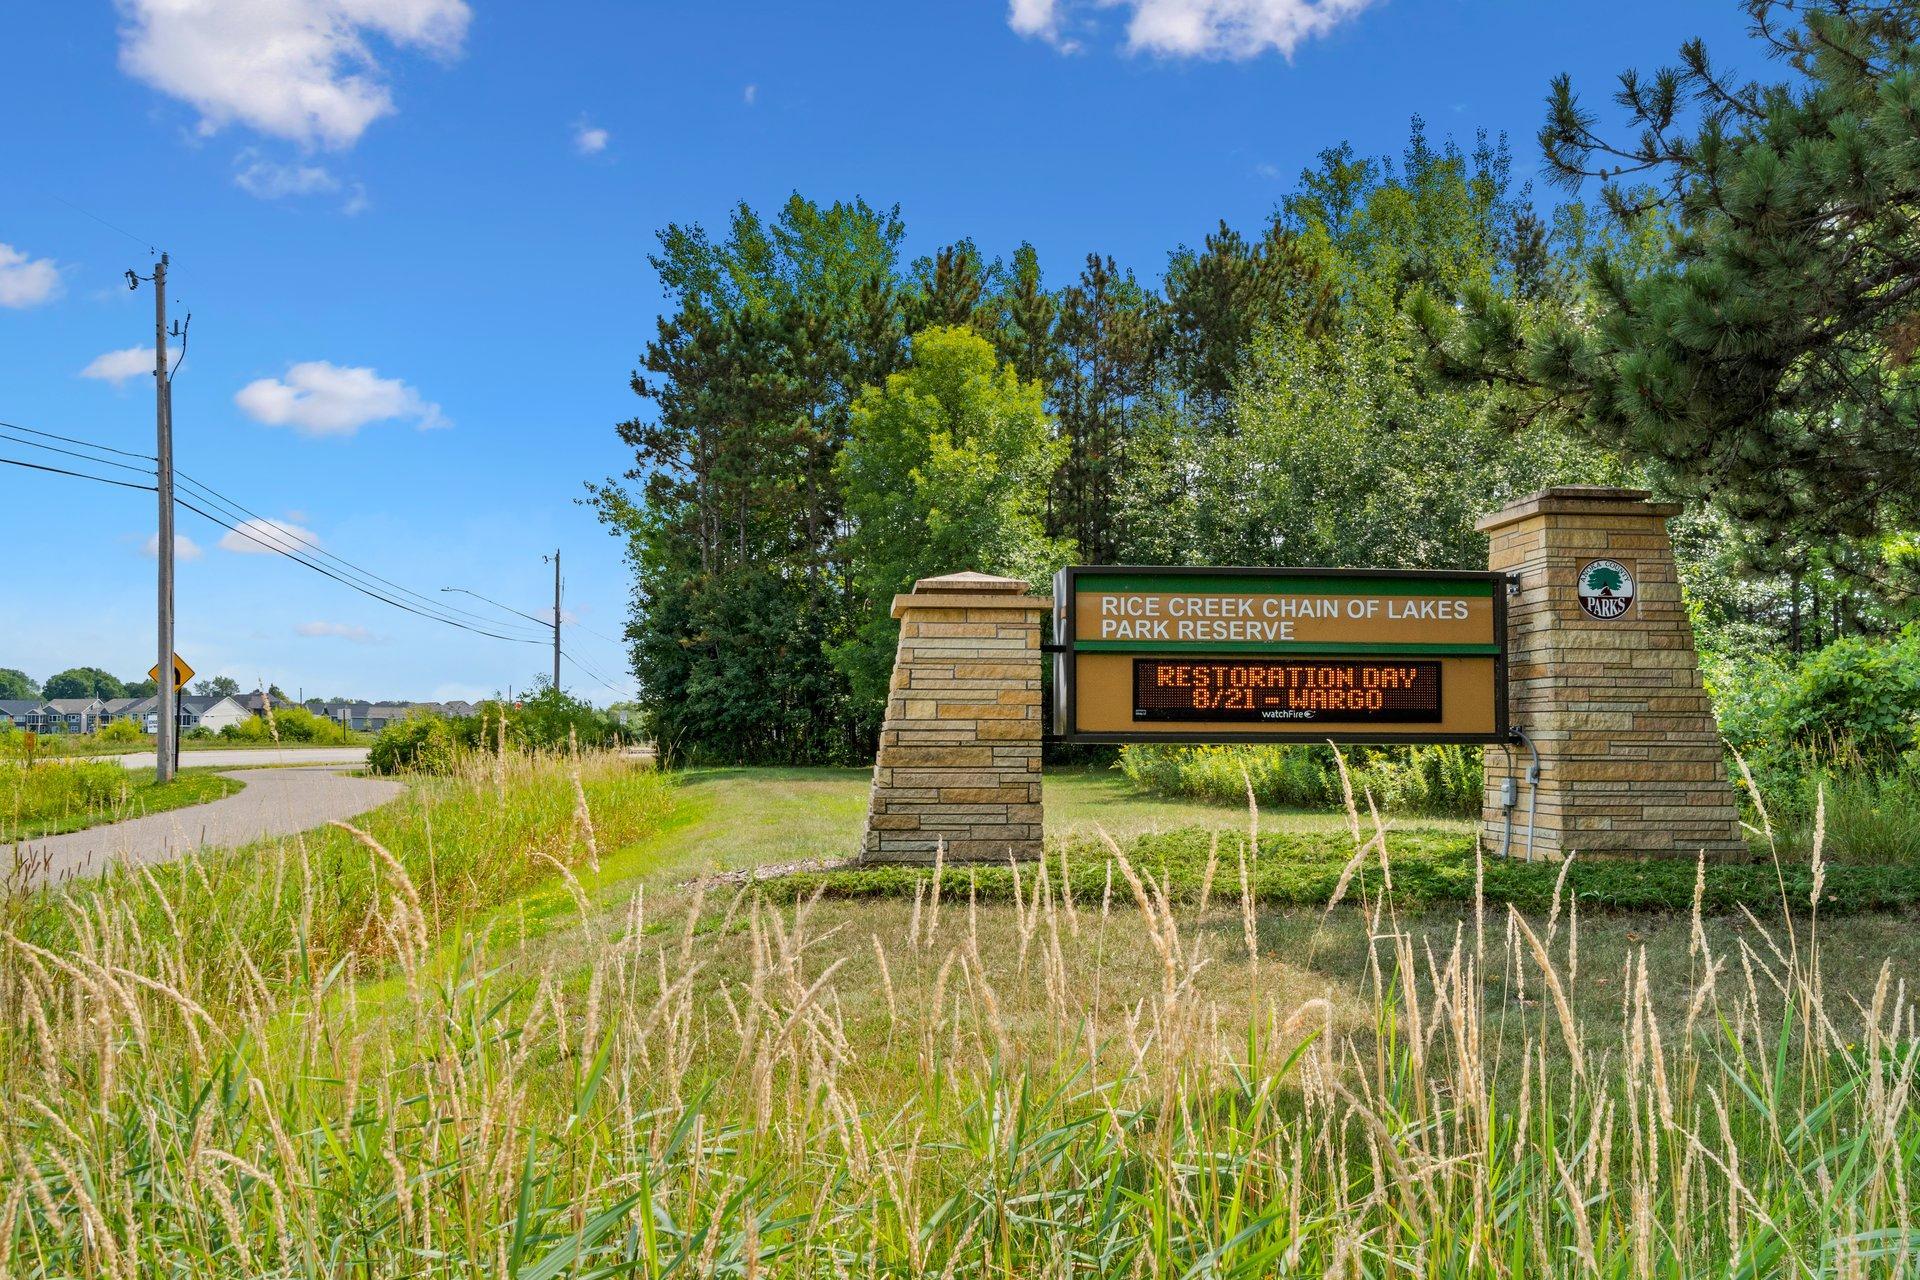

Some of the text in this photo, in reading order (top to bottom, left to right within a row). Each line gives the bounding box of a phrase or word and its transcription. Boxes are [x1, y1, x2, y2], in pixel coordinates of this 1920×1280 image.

[1604, 560, 1631, 582] COUNTY
[1102, 596, 1469, 620] RICE CREEK CHAIN OF LAKES
[1587, 597, 1626, 617] PARKS
[1102, 619, 1295, 641] PARK RESERVE
[1157, 666, 1417, 688] RESTORATION DAY
[1193, 688, 1255, 708] 8/21
[1289, 689, 1382, 709] WARGO
